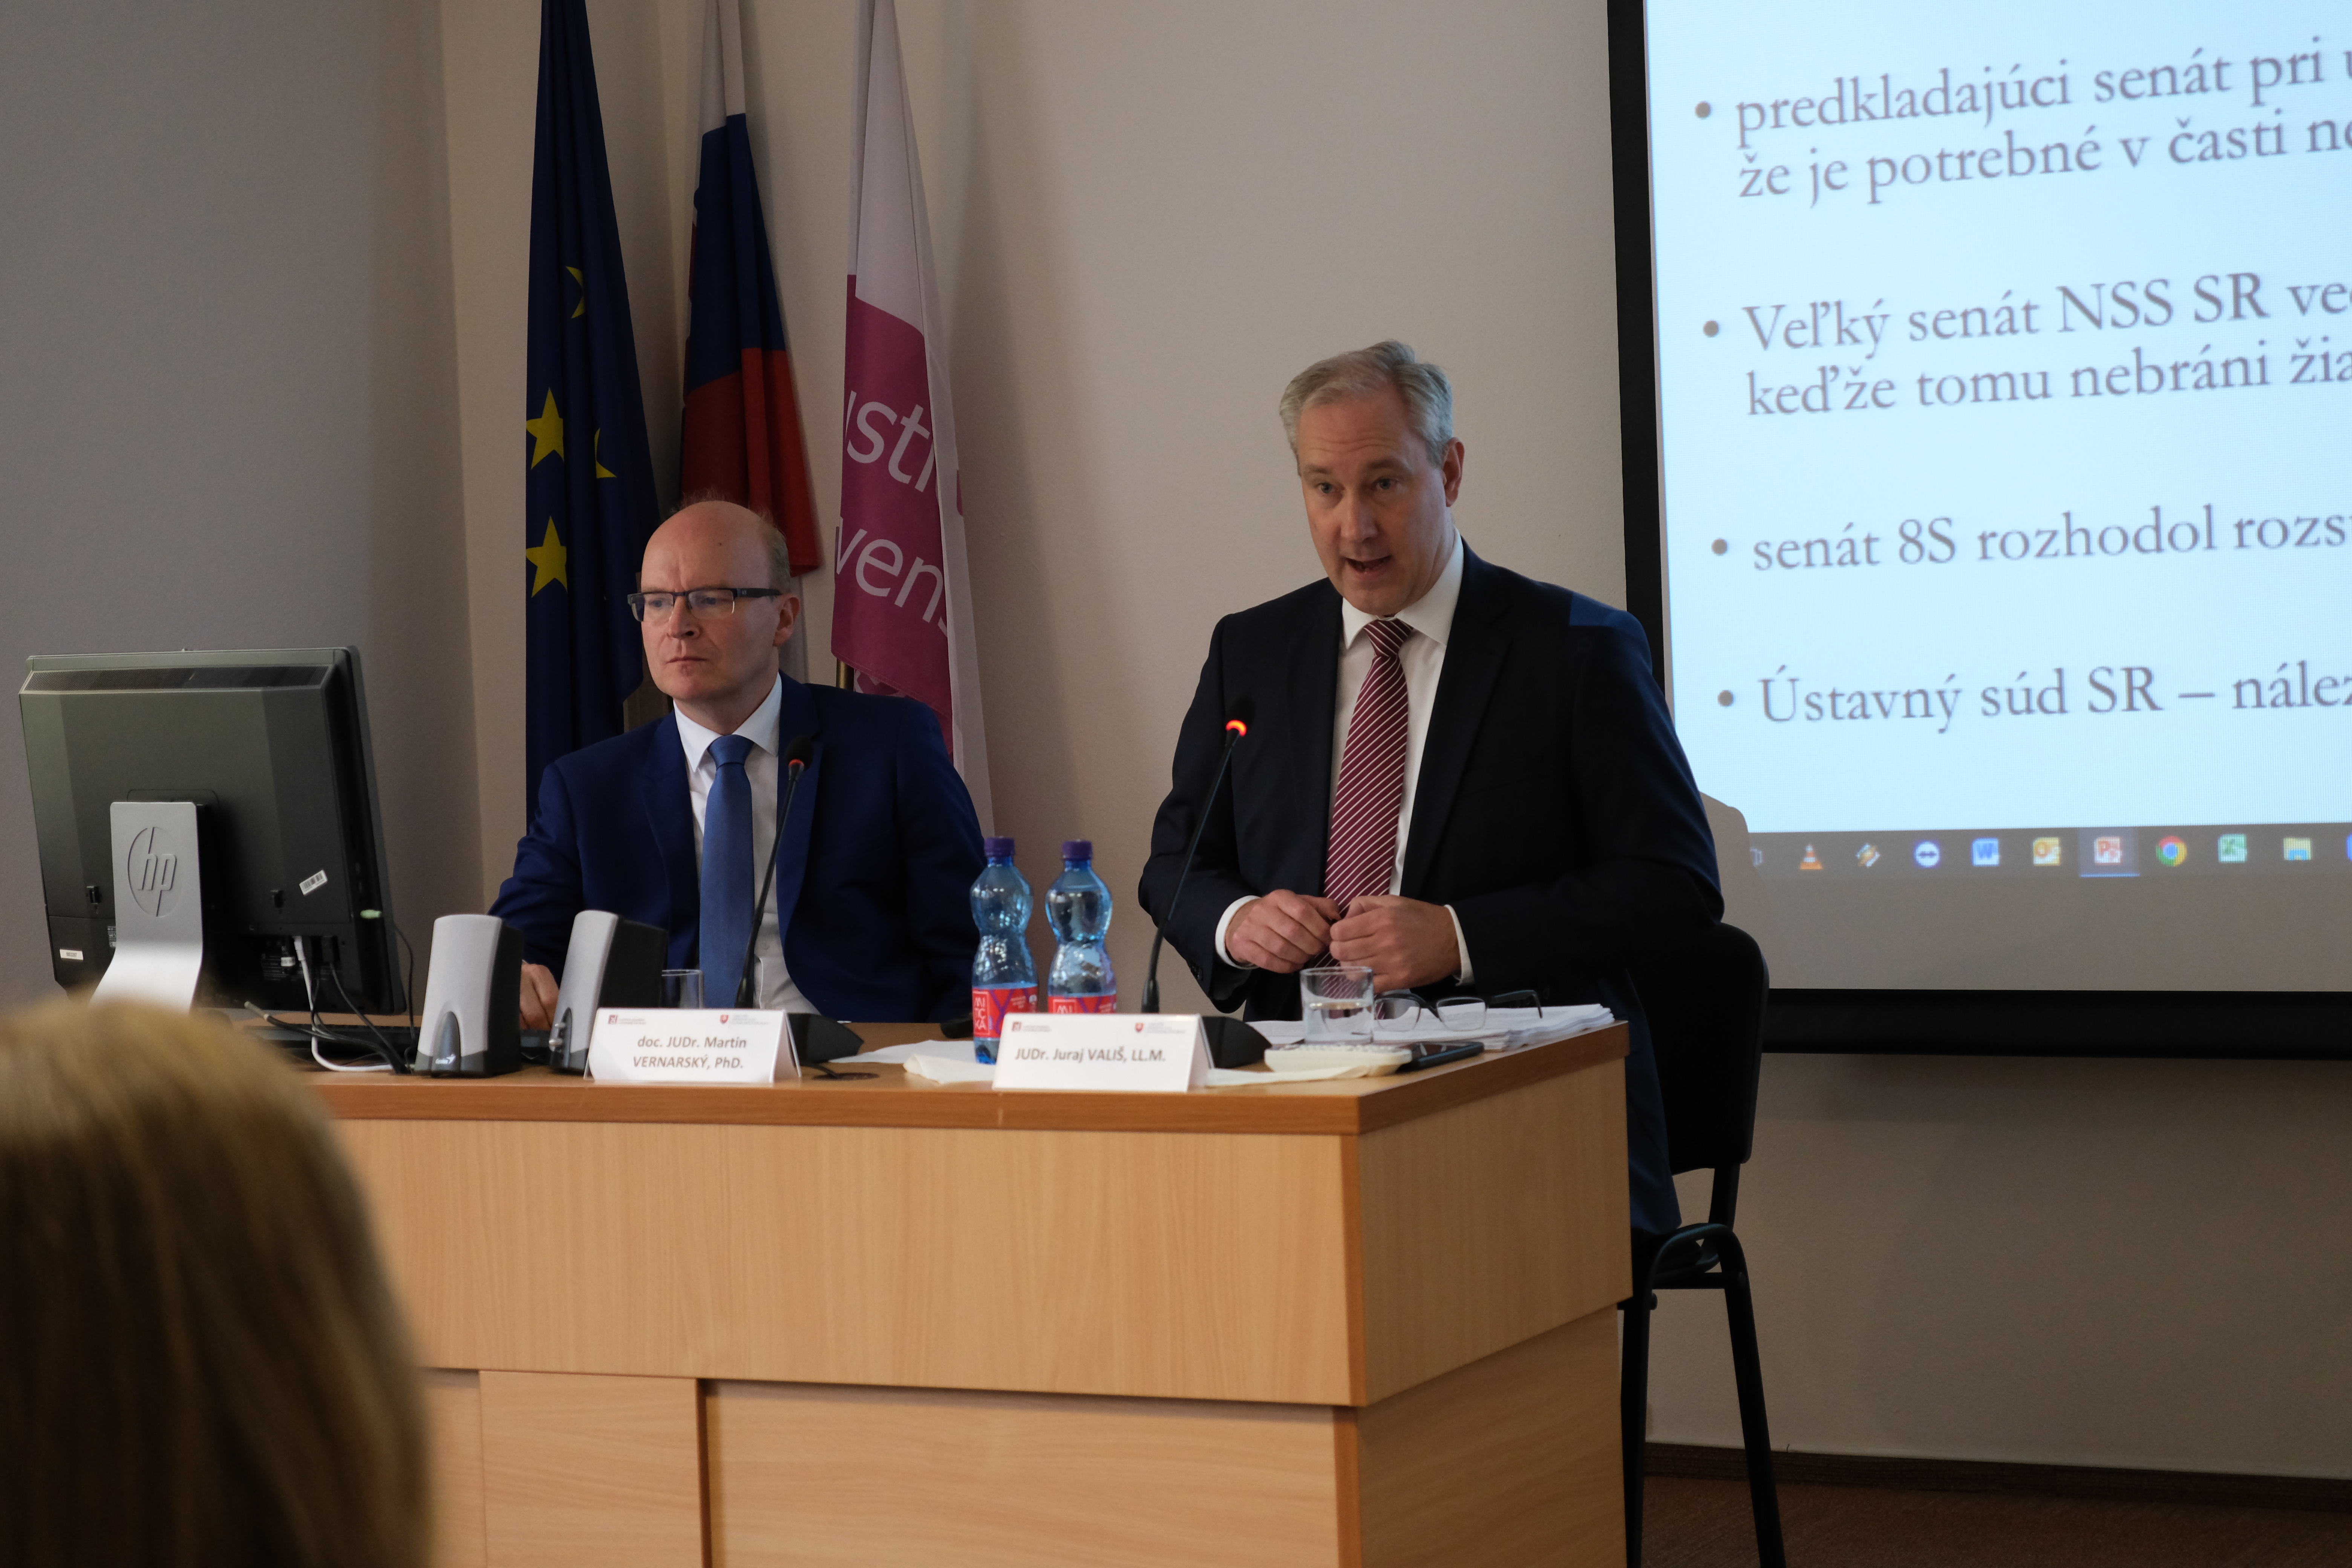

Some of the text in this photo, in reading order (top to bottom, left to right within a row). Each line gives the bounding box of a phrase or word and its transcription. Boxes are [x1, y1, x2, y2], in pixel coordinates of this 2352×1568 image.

[1735, 59, 2071, 149] predkladajúci
[2094, 47, 2231, 102] senát
[2249, 36, 2324, 107] pri
[1739, 155, 1790, 197] že
[1810, 147, 1848, 208] je
[1867, 125, 2101, 205] potrebné
[2120, 137, 2149, 167] v
[2168, 108, 2287, 164] časti
[1743, 272, 2352, 360] Veľký senát NSS SR ve
[1746, 365, 1895, 416] keďže
[1917, 371, 2052, 406] tomu
[2071, 339, 2270, 397] nebráni
[1753, 503, 2352, 570] senát 8S rozhodol rozs
[1760, 665, 1962, 734] Ústavný
[1981, 667, 2069, 717] súd
[2088, 666, 2164, 714] SR
[136, 827, 177, 917] hp
[633, 1054, 743, 1070] VERNARSKÝ, PhD.
[637, 1036, 747, 1048] doc. JUDr. Martin
[1015, 1046, 1165, 1064] JUDr. Juraj VALIŠ, LL.M.
